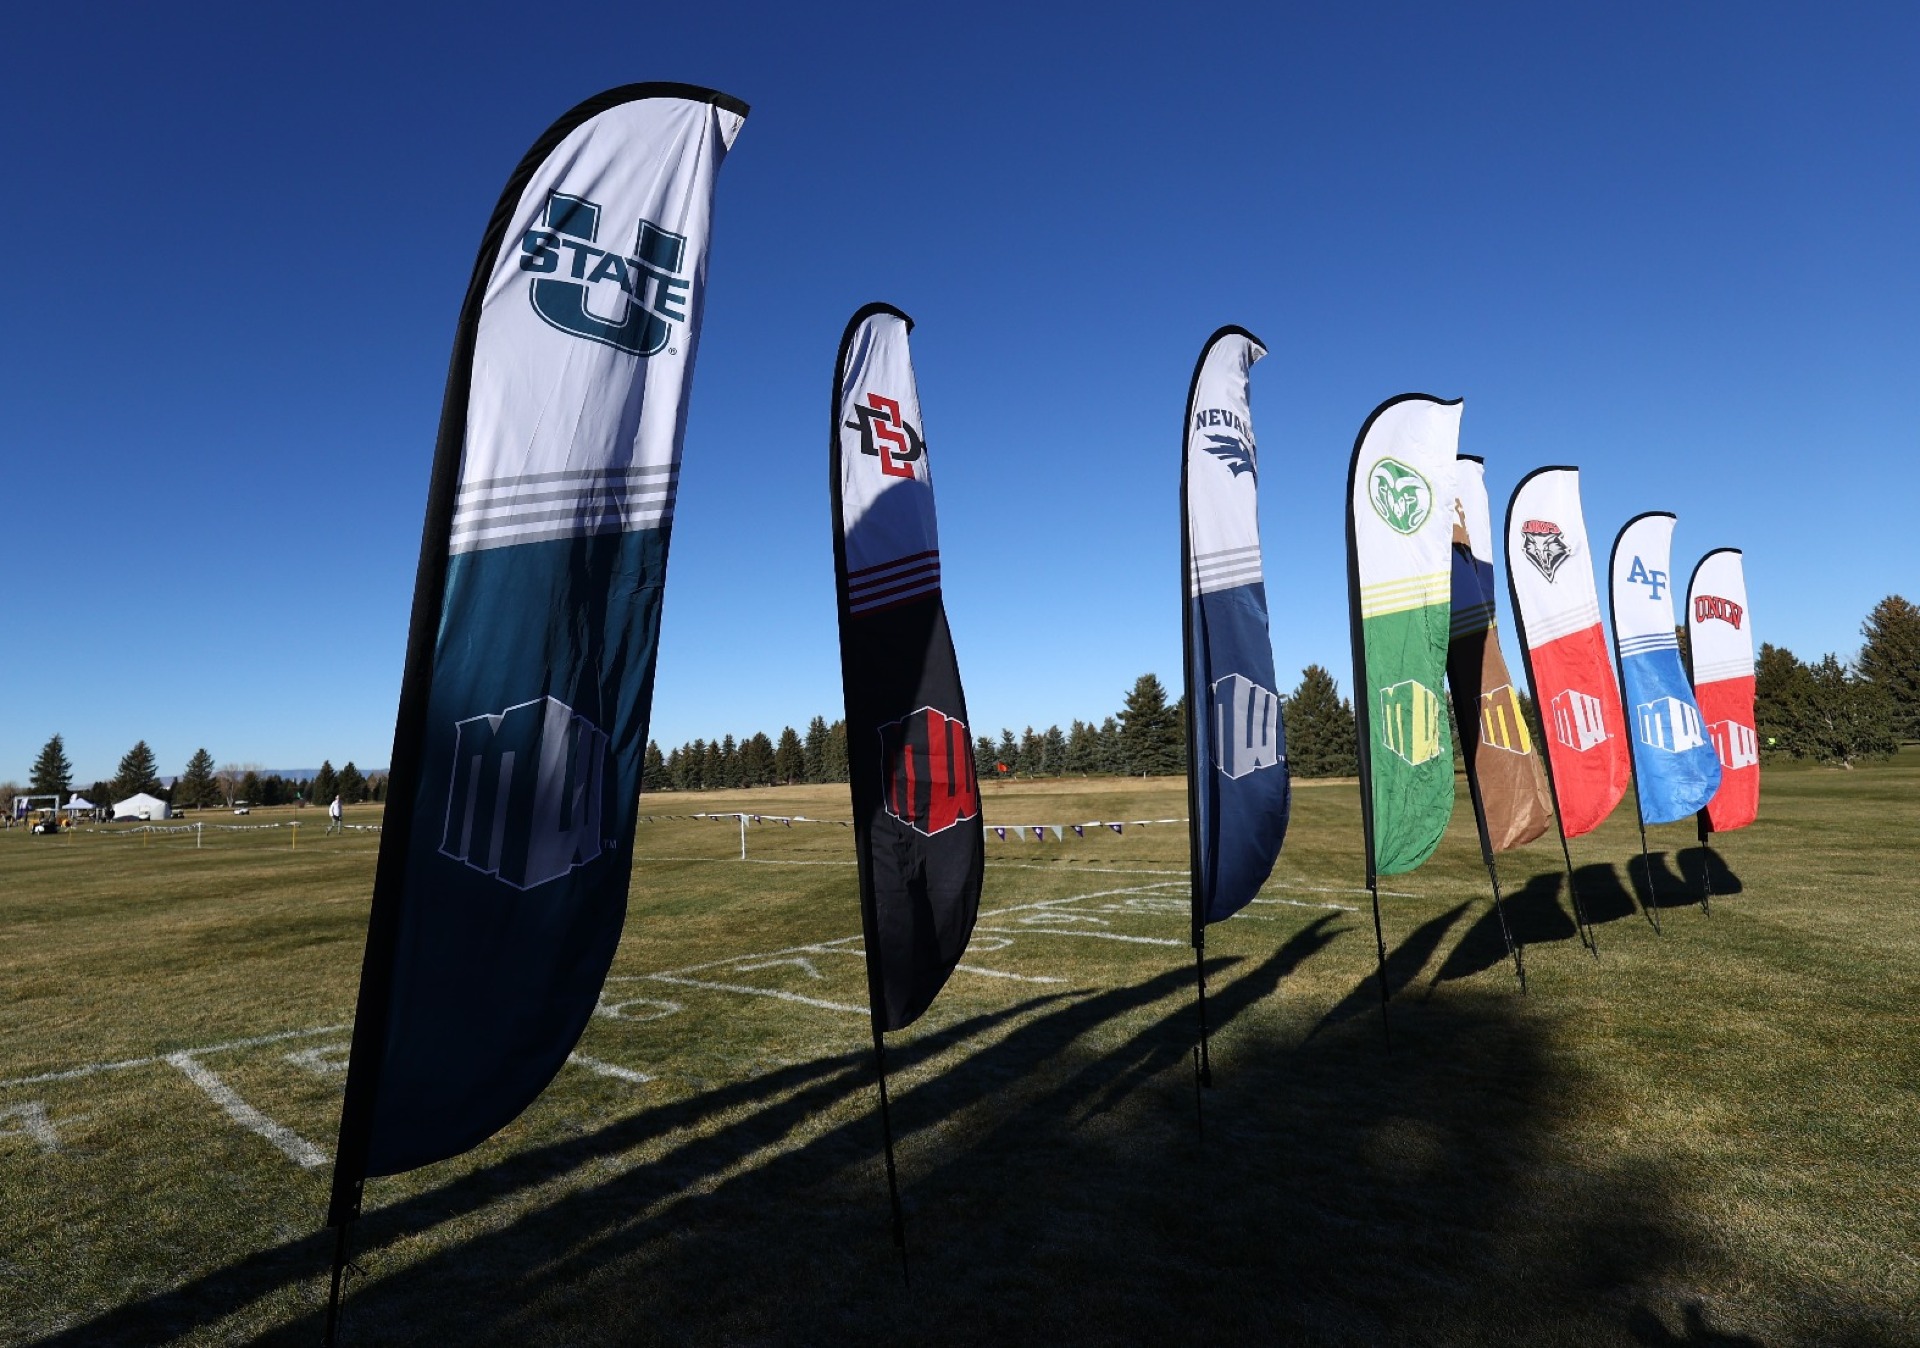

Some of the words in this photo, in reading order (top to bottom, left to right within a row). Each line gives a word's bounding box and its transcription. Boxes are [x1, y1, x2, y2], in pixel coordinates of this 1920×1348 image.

[519, 231, 689, 322] STATE
[1626, 555, 1667, 600] AF
[1694, 595, 1743, 630] UNLV
